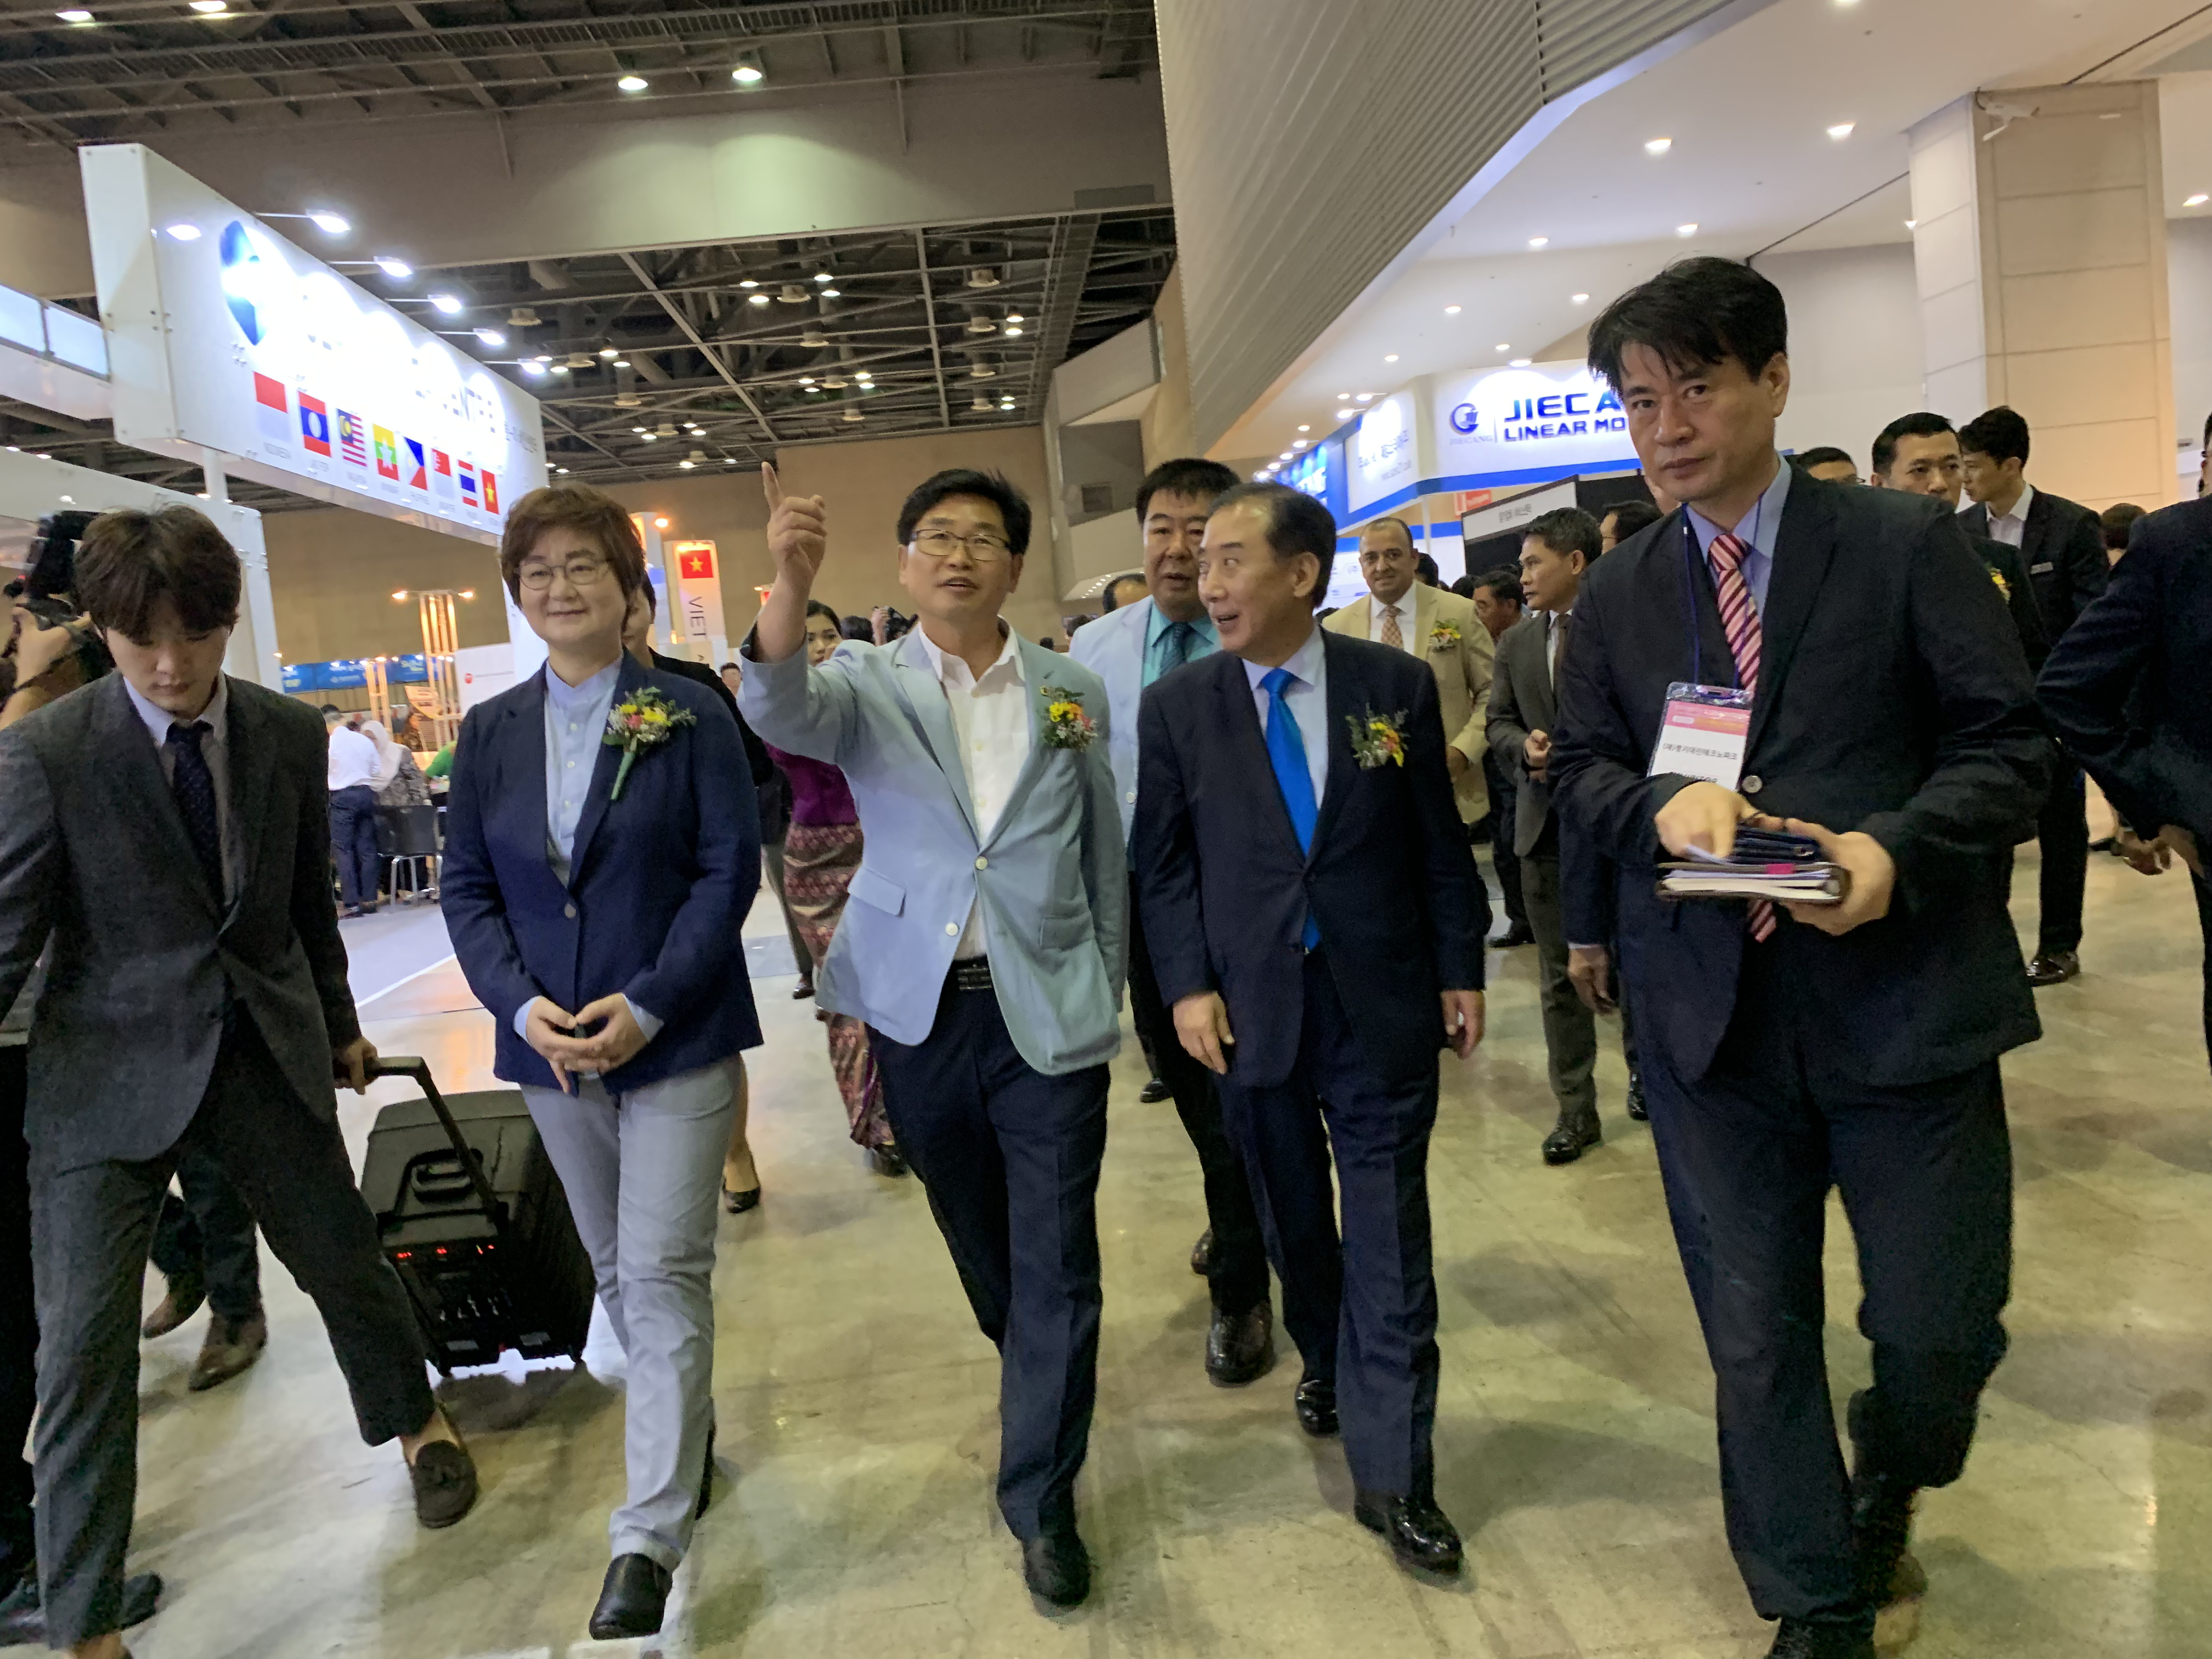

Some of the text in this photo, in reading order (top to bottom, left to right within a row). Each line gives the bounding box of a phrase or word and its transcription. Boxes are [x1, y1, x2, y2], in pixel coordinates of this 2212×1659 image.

[1504, 390, 1623, 423] JIECA
[1504, 416, 1626, 442] LINEAR MO
[688, 596, 708, 640] VIET
